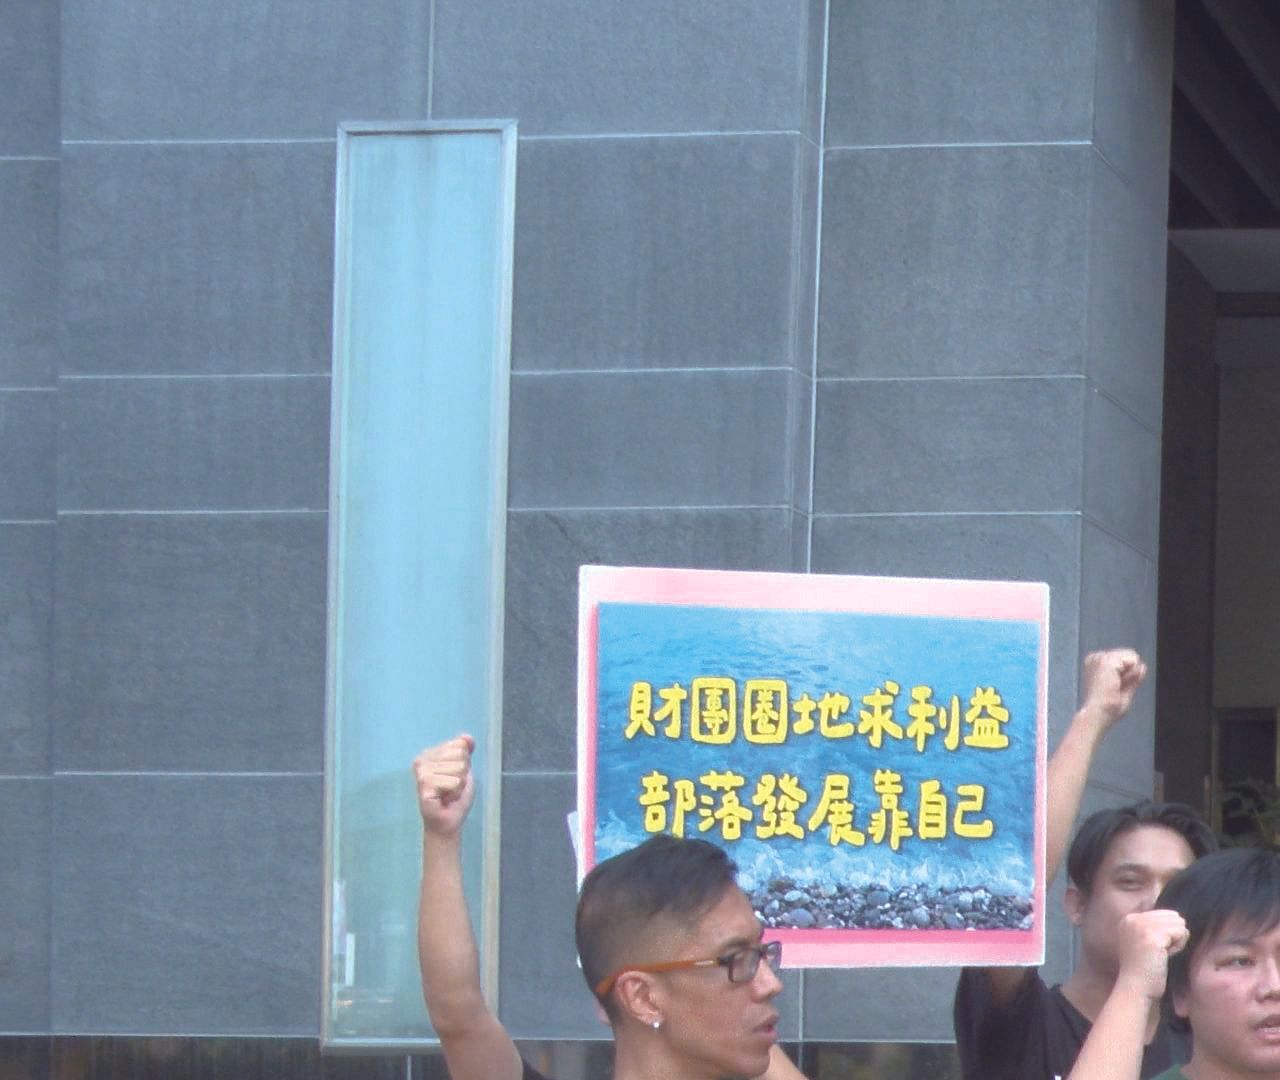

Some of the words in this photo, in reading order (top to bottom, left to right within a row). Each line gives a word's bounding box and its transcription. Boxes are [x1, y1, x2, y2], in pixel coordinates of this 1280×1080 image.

[624, 677, 1011, 751] 財團圈地求利益
[638, 769, 995, 852] 部落發展靠自己
